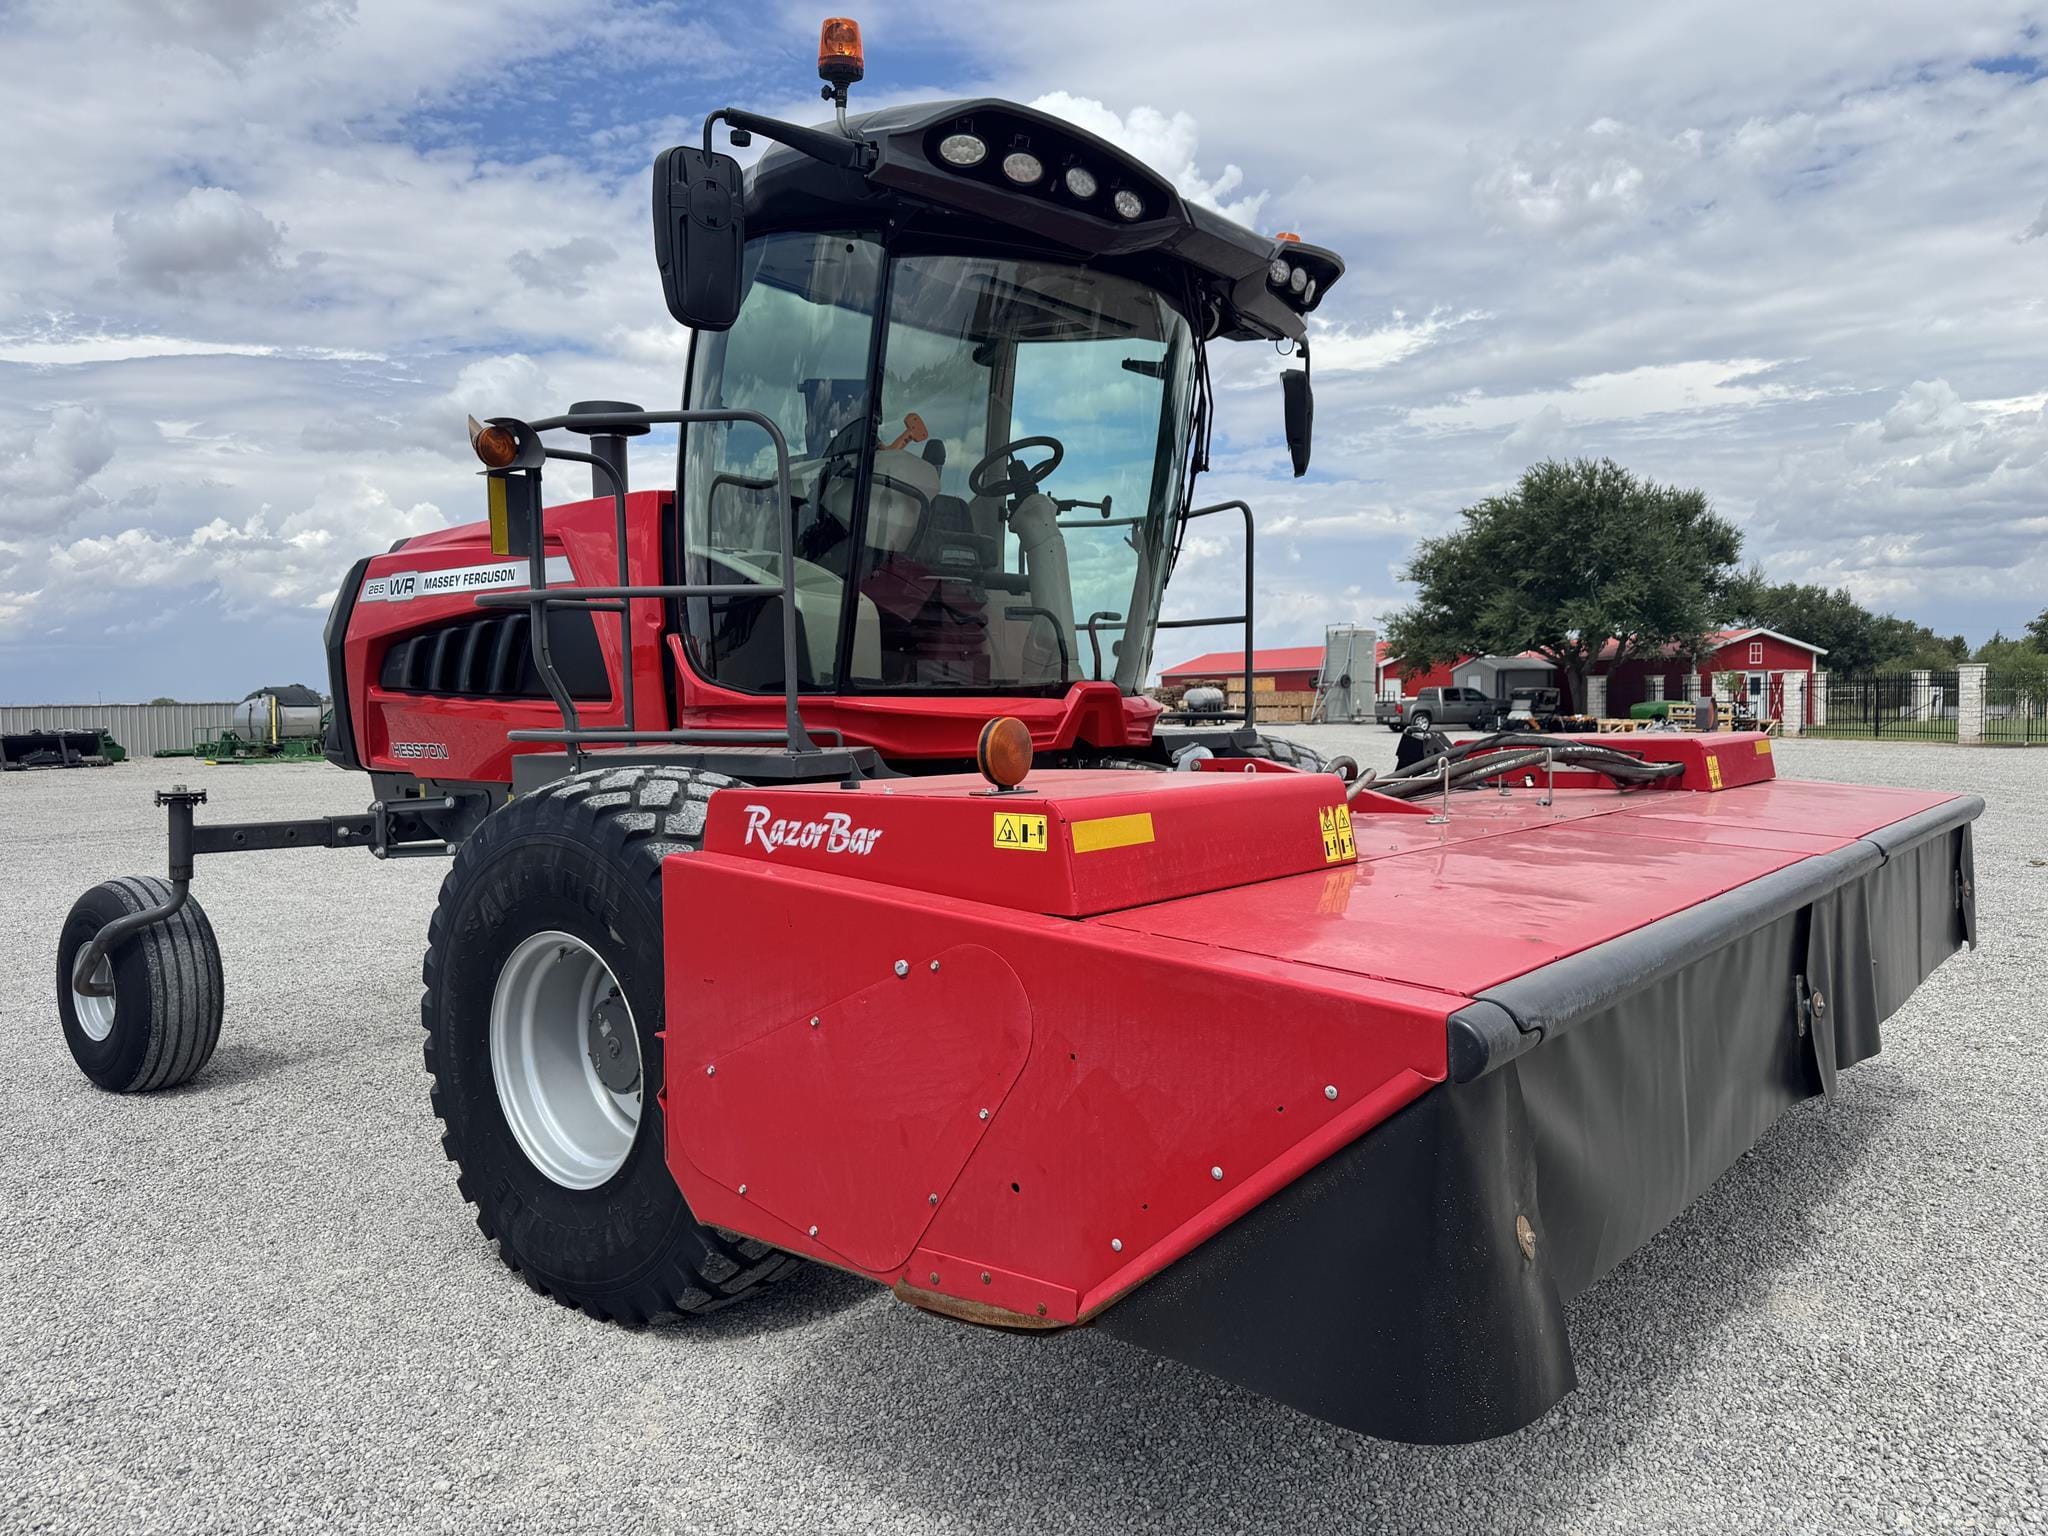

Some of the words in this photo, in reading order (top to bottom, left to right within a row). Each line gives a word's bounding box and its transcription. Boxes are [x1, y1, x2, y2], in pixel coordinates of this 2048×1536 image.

[368, 583, 385, 595] 265
[389, 576, 415, 596] WR
[423, 574, 461, 590] MASSEY
[463, 568, 516, 587] FERGUSON
[391, 742, 449, 760] HESSTON
